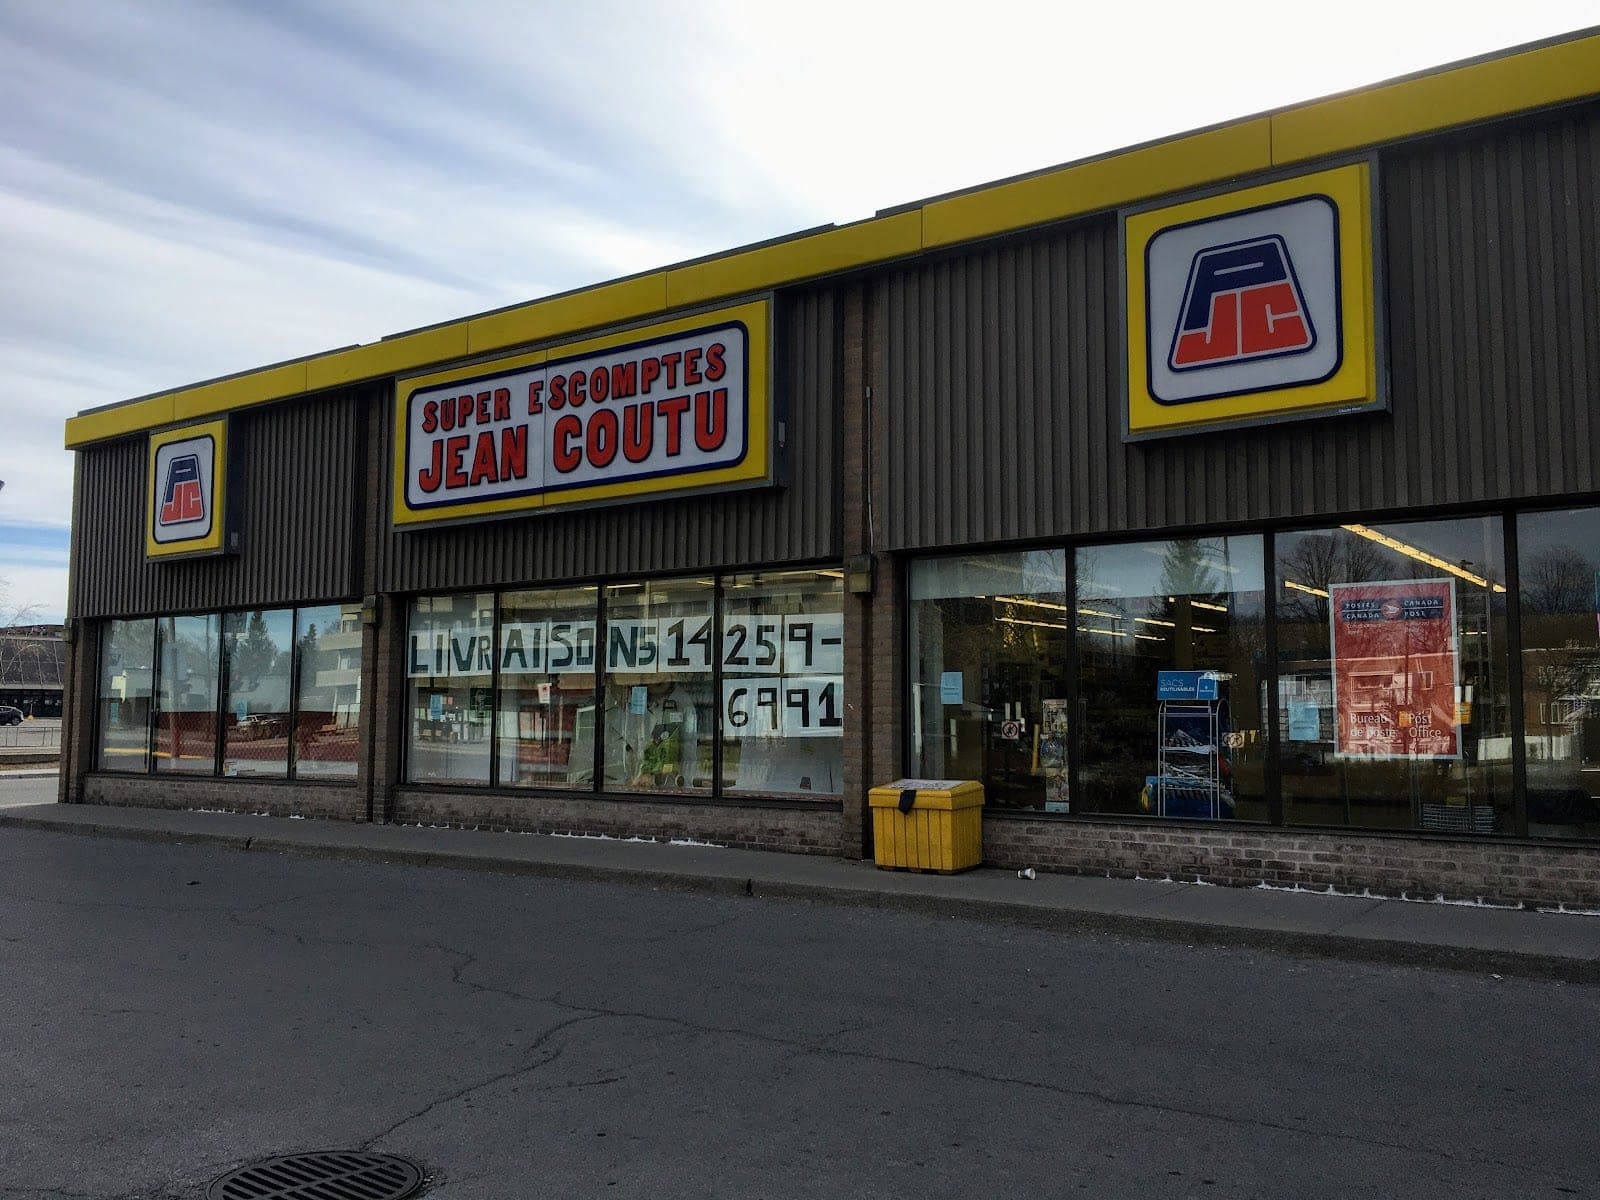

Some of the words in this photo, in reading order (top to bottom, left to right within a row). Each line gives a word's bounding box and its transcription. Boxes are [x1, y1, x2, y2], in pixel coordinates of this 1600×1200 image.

[421, 387, 511, 433] SUPER
[528, 343, 727, 416] ESCOMPTES
[418, 424, 528, 493] JEAN
[552, 387, 728, 473] COUTU
[1404, 599, 1439, 607] CANADA
[410, 624, 638, 674] LIVRAISON
[638, 615, 713, 667] 514
[1160, 679, 1184, 687] SACS
[728, 682, 843, 730] 6991
[1350, 713, 1388, 724] Bureau
[1409, 713, 1432, 724] Post
[1350, 727, 1363, 737] de
[1409, 727, 1442, 737] Office
